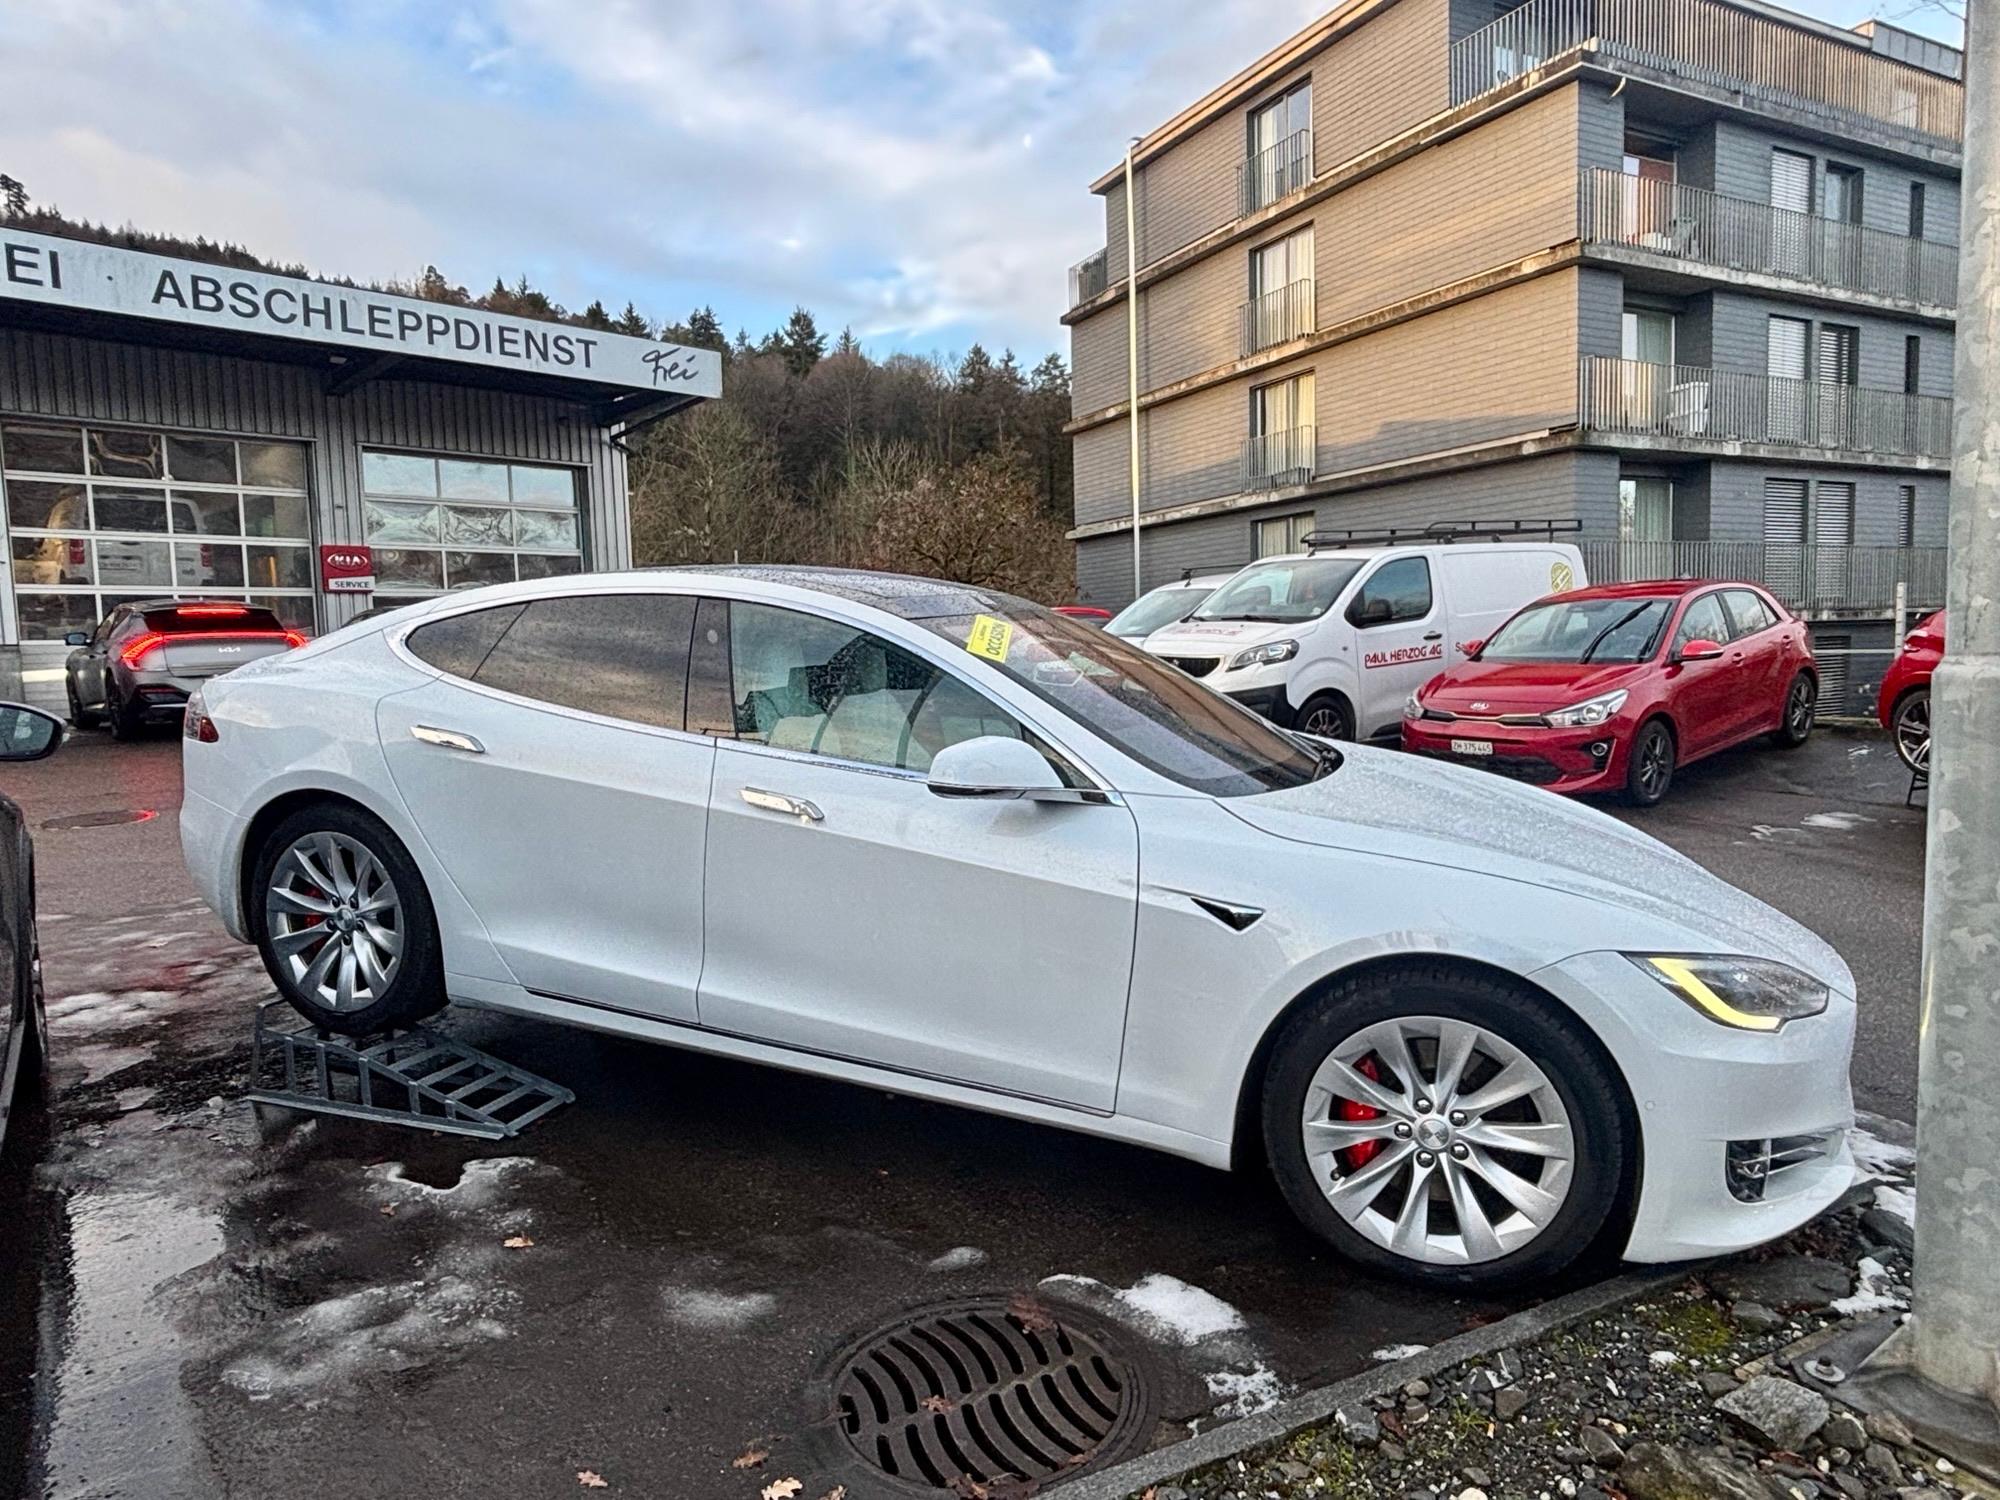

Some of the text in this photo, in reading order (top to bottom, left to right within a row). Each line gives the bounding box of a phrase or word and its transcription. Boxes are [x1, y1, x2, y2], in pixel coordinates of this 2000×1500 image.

[151, 269, 597, 368] ABSCHLEPPDIENST
[641, 347, 699, 386] Frei
[334, 555, 361, 566] KIA
[1364, 652, 1388, 666] PAUL
[1390, 646, 1427, 661] HERZOG
[1429, 644, 1442, 655] AG
